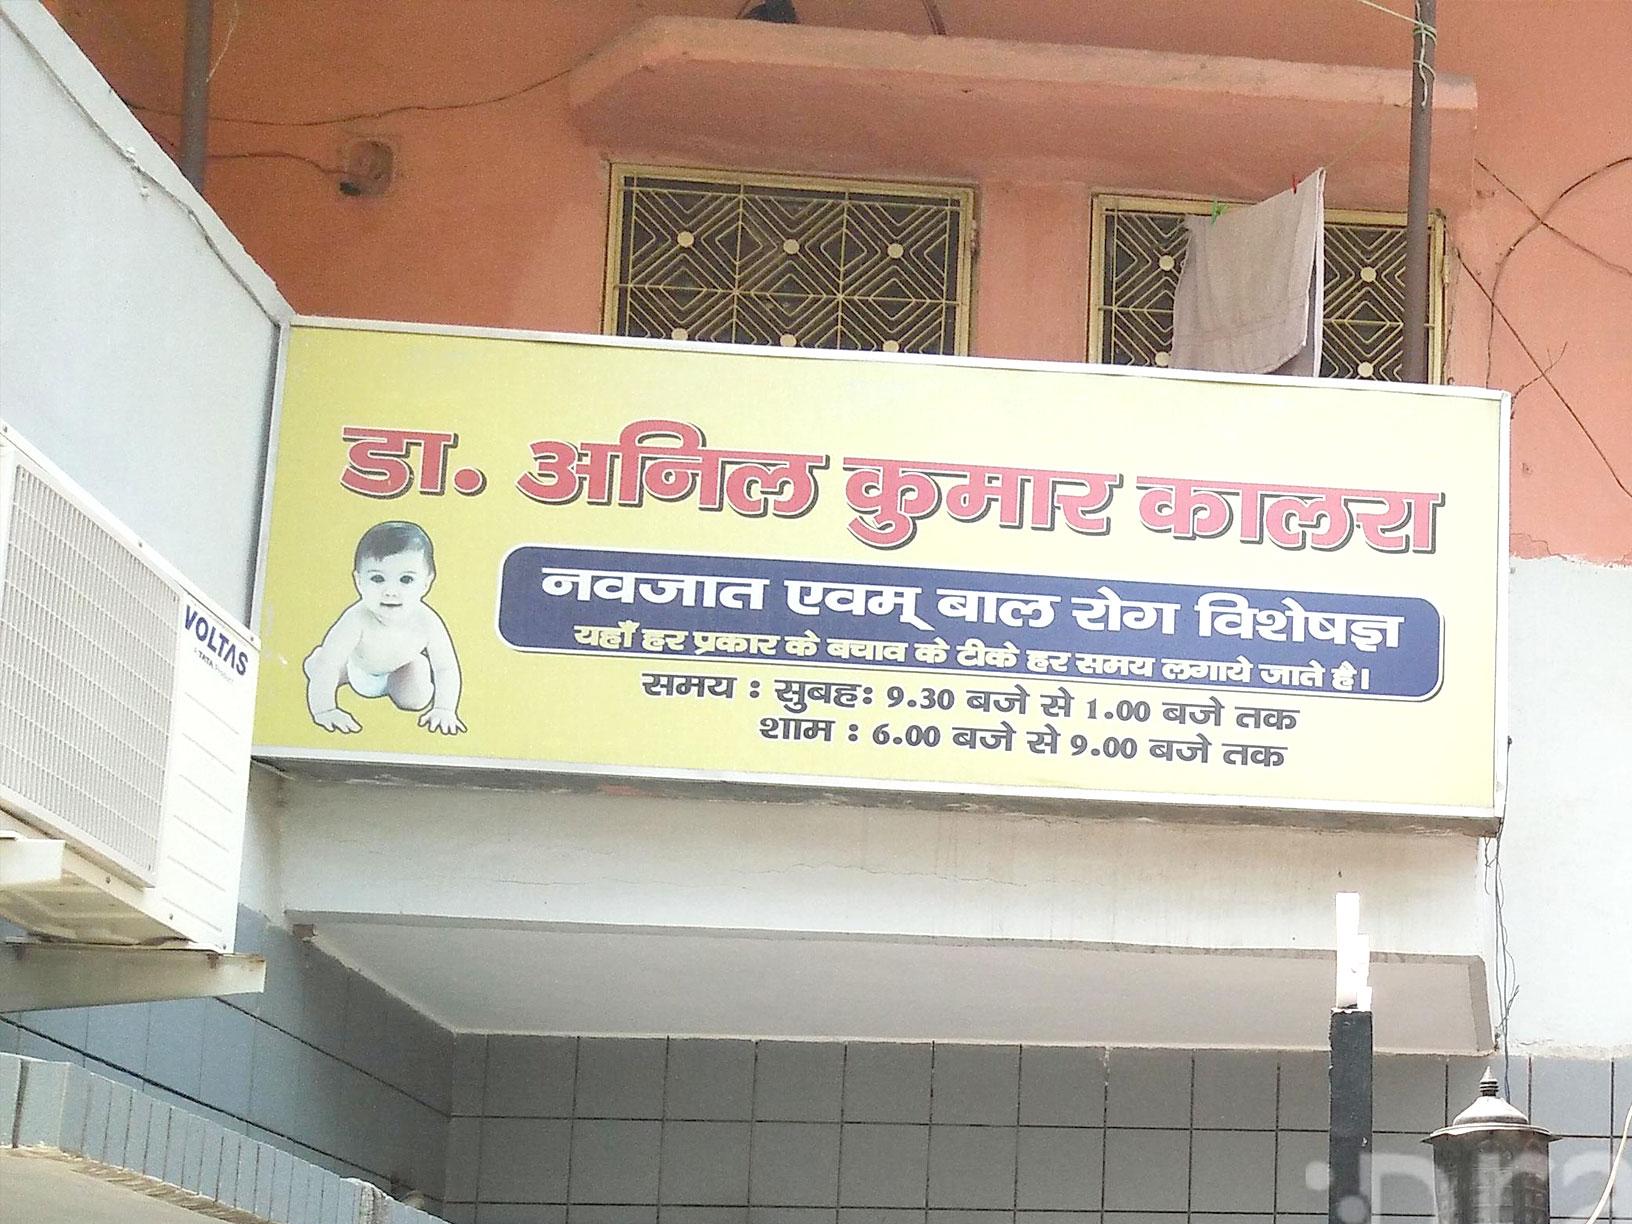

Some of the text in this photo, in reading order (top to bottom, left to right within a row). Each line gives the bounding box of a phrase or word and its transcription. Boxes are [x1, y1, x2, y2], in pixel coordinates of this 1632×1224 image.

[341, 419, 1445, 554] डा. अनिल कुमार कालरा
[185, 604, 249, 676] VOLTAS
[541, 567, 1405, 653] नवजात एवम् बाल रोग विशेषज्ञ
[573, 619, 640, 649] यहाँ
[641, 628, 689, 651] हर
[692, 630, 781, 657] प्रकार
[784, 629, 821, 657] के
[826, 634, 908, 663] बचाव
[914, 637, 950, 666] के
[956, 638, 1020, 668] टीके
[1026, 649, 1072, 674] हर
[1075, 652, 1156, 678] समय
[1161, 655, 1256, 683] लगाये
[1259, 659, 1326, 688] जाते
[642, 673, 738, 699] समय
[886, 685, 956, 711] 9.30
[967, 684, 1030, 715] बजे
[1040, 687, 1075, 718] से
[1087, 697, 1152, 723] 1.00
[1162, 696, 1225, 727] बजे
[1235, 706, 1301, 731] तक
[760, 716, 837, 742] शाम
[872, 723, 942, 748] 6.00
[953, 721, 1016, 752] बजे
[1026, 724, 1061, 755] से
[1071, 733, 1138, 759] 9.00
[1149, 733, 1212, 763] बजे
[1222, 743, 1289, 768] तक
